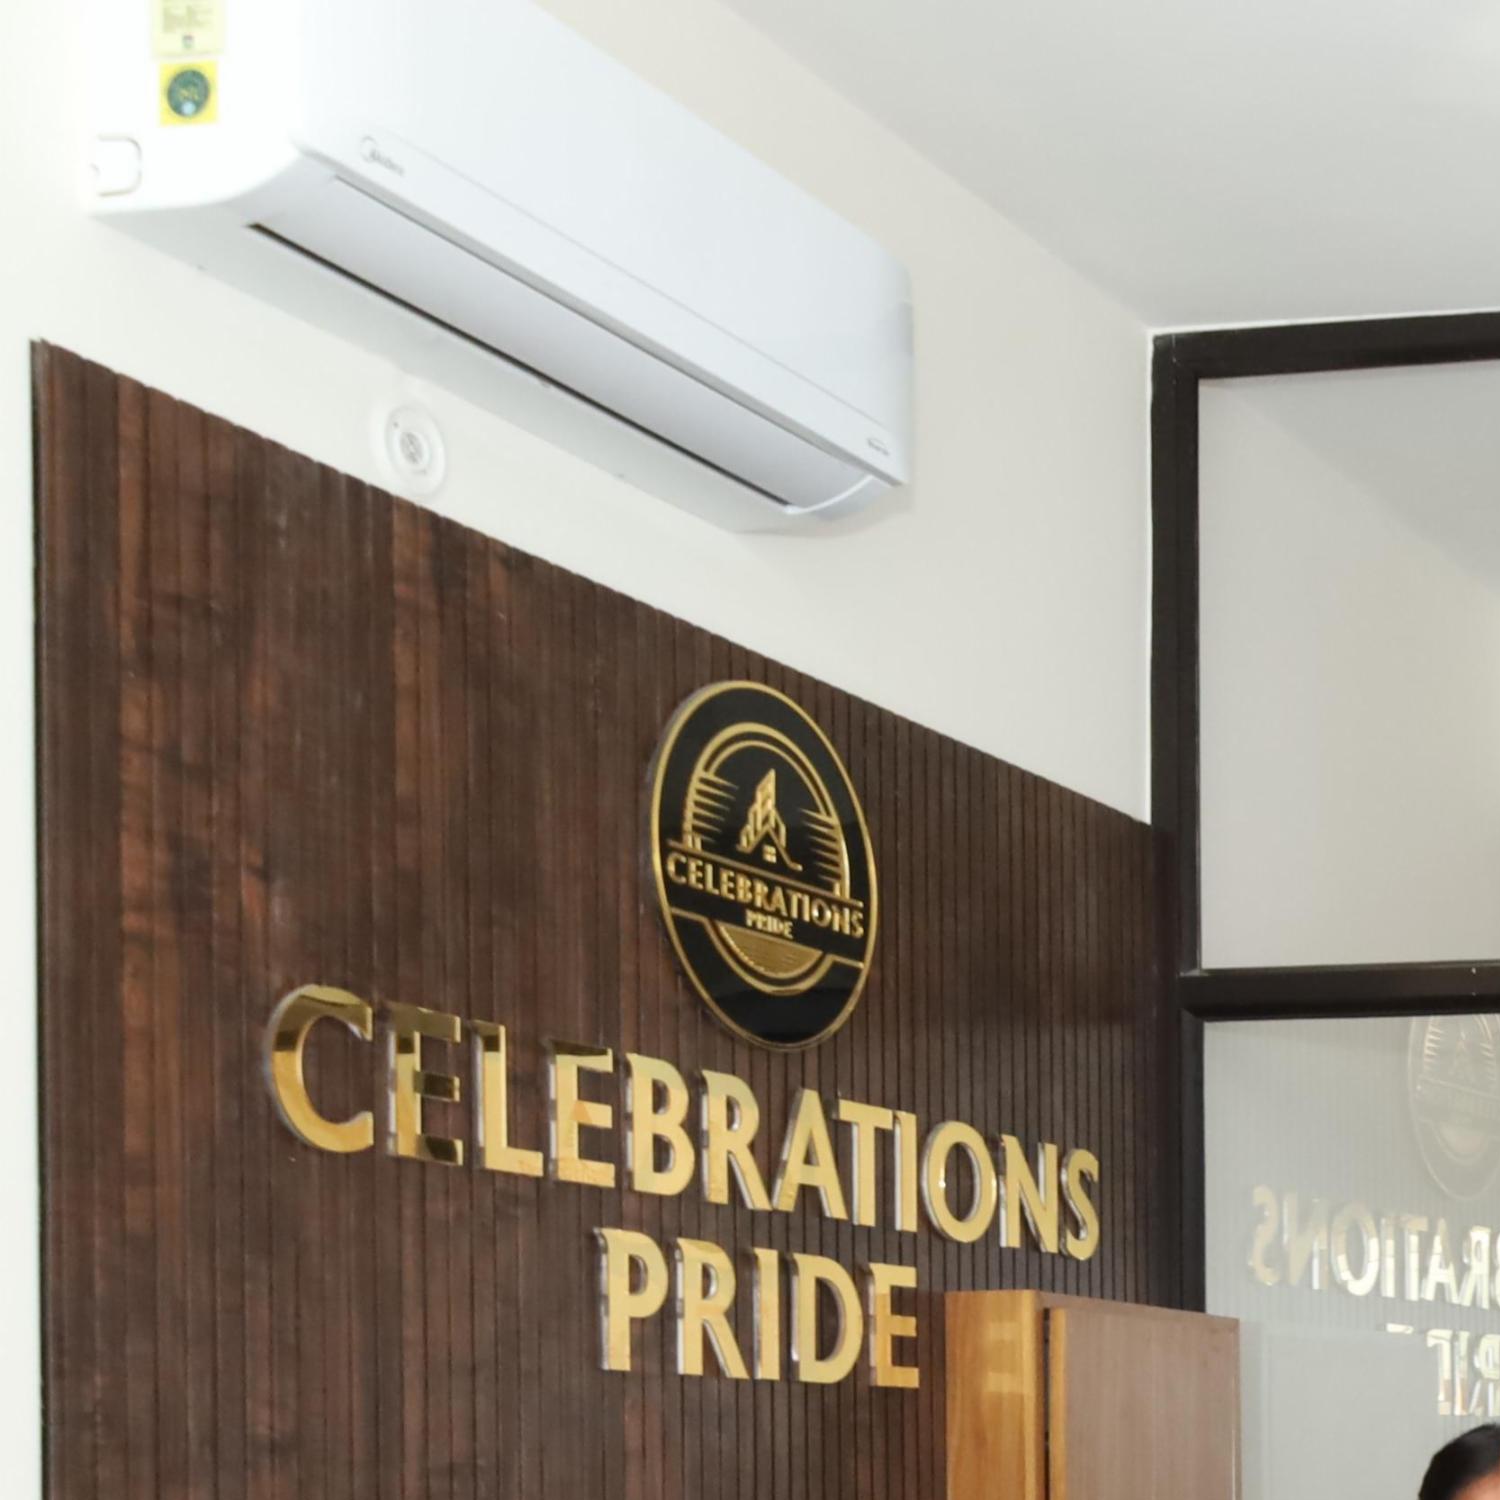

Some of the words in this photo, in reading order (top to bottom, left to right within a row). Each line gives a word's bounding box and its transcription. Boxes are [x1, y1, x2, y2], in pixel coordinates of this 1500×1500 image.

[666, 852, 864, 939] CELEBRATIONS
[745, 909, 794, 940] PRIDE
[267, 983, 1101, 1262] CELEBRATIONS
[595, 1226, 920, 1389] PRIDE
